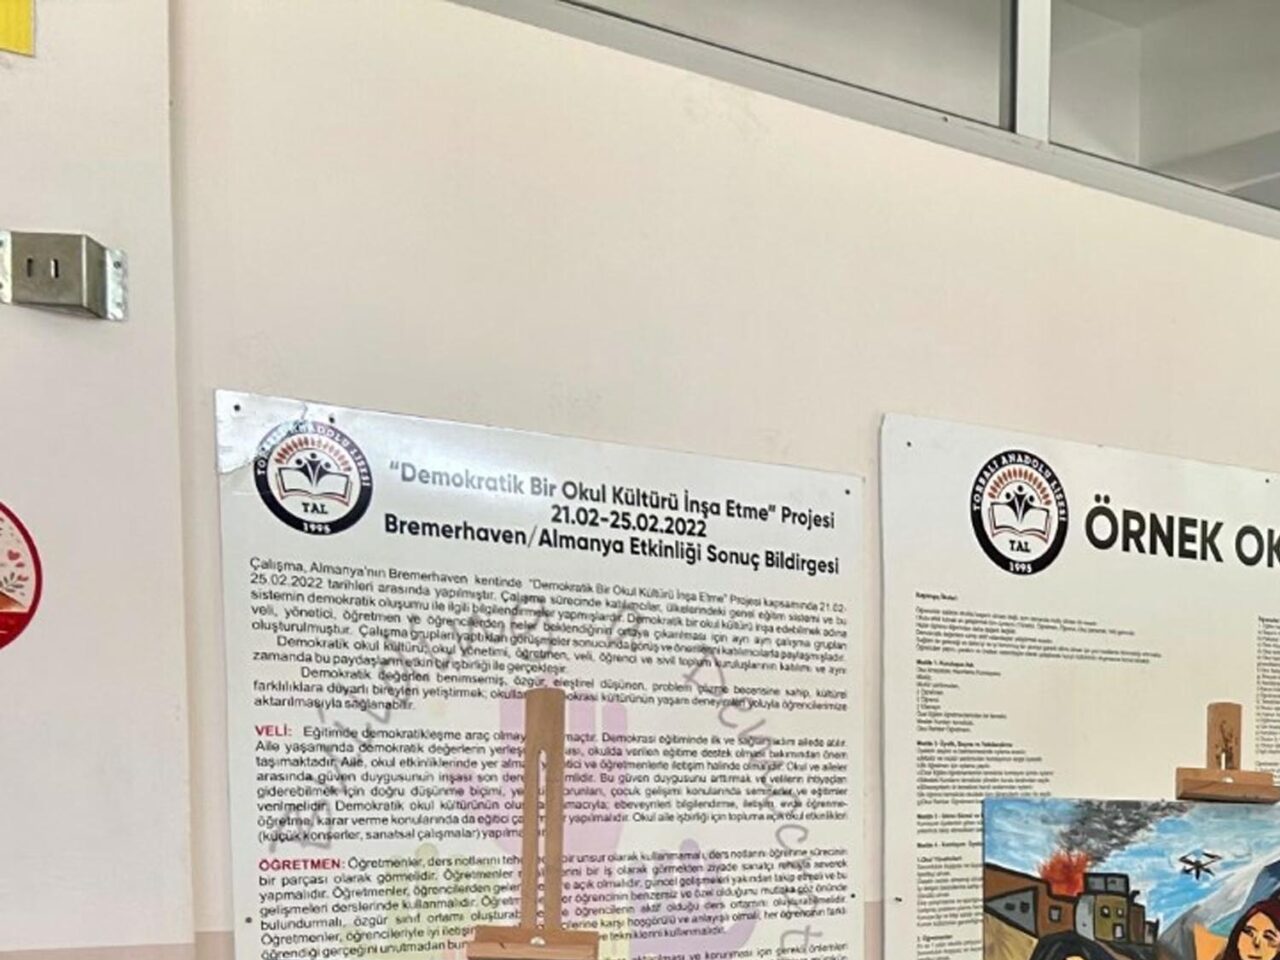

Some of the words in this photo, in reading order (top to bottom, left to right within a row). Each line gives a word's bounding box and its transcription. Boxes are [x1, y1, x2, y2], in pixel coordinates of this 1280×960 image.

[973, 460, 999, 511] TORBALI
[1001, 453, 1052, 478] ANADOLU
[390, 460, 525, 495] “Demokratik
[530, 476, 557, 497] Bir
[562, 480, 606, 503] Okul
[612, 486, 679, 511] Kültürü
[684, 489, 721, 519] İnşa
[726, 499, 776, 521] Etme"
[781, 505, 835, 531] Projesi
[301, 502, 328, 515] TAL
[551, 504, 707, 538] 21.02-25.02.2022
[1085, 493, 1224, 563] ÖRNEK
[384, 513, 625, 557] Bremerhaven/Almanya
[630, 536, 702, 565] Etkinliği
[707, 544, 760, 571] Sonuç
[765, 550, 840, 577] Bildirgesi
[1008, 540, 1031, 553] TAL
[249, 559, 307, 575] Çalışma,
[309, 563, 385, 581] Almanya'nın
[388, 568, 468, 584] Bremerhaven
[474, 574, 522, 588] kentinde
[1009, 561, 1032, 574] 1995
[249, 573, 323, 588] 25.02.2022
[327, 578, 373, 592] tarihleri
[378, 582, 429, 595] arasında
[434, 585, 495, 603] yapılmıştır.
[250, 589, 304, 602] sistemin
[307, 592, 376, 607] demokratik
[378, 597, 429, 613] oluşumu
[431, 600, 444, 611] ile
[447, 601, 469, 615] ilgili
[283, 607, 336, 622] yönetici,
[342, 610, 401, 626] öğretmen
[406, 616, 421, 625] ve
[358, 625, 408, 641] Çalışma
[276, 636, 349, 649] Demokratik
[353, 639, 379, 651] okul
[252, 650, 312, 663] zamanda
[314, 652, 330, 663] bu
[492, 660, 504, 671] ile
[253, 682, 323, 694] farklılıklara
[326, 684, 369, 698] duyarlı
[300, 668, 372, 681] Demokratik
[436, 672, 507, 688] benimsemiş,
[552, 677, 594, 691] eleştirel
[652, 680, 692, 695] problem
[253, 696, 342, 711] aktarılmasıyla
[253, 725, 292, 737] VELİ:
[302, 726, 358, 740] Eğitimde
[361, 728, 461, 743] demokratikleşme
[464, 732, 490, 743] araç
[255, 740, 279, 751] Aile
[284, 741, 353, 755] yaşamında
[358, 742, 422, 754] demokratik
[427, 743, 485, 757] değerlerin
[370, 757, 395, 768] okul
[398, 757, 477, 768] etkinliklerinde
[480, 760, 497, 771] yer
[256, 770, 312, 781] arasında
[317, 771, 356, 784] güven
[360, 771, 434, 784] duygusunun
[438, 771, 472, 784] inşası
[477, 774, 497, 782] son
[600, 772, 615, 783] Bu
[618, 772, 650, 785] güven
[653, 772, 706, 786] duygusunu
[256, 785, 337, 799] giderebilmek
[343, 785, 365, 798] için
[370, 785, 405, 798] doğru
[409, 785, 464, 798] düşünme
[469, 785, 505, 798] biçimi,
[610, 785, 640, 798] çocuk
[335, 800, 404, 811] Demokratik
[409, 800, 434, 810] okul
[439, 799, 499, 810] kültürünün
[316, 814, 349, 825] karar
[351, 816, 388, 825] verme
[390, 813, 459, 824] konularında
[461, 813, 475, 824] da
[365, 829, 414, 840] sanatsal
[417, 828, 480, 842] çalışmalar)
[259, 856, 345, 869] ÖĞRETMEN:
[347, 854, 425, 870] Öğretmenler,
[427, 855, 452, 866] ders
[258, 873, 276, 884] bir
[281, 874, 328, 886] parçası
[333, 871, 371, 882] olarak
[376, 869, 437, 884] görmelidir.
[443, 865, 512, 882] Öğretmenler
[259, 887, 328, 902] yapmalıdır.
[331, 883, 410, 900] Öğretmenler,
[259, 902, 327, 918] gelişmeleri
[331, 899, 399, 912] derslerinde
[260, 916, 345, 932] bulundurmalı,
[353, 915, 387, 929] özgür
[260, 929, 342, 947] Öğretmenler,
